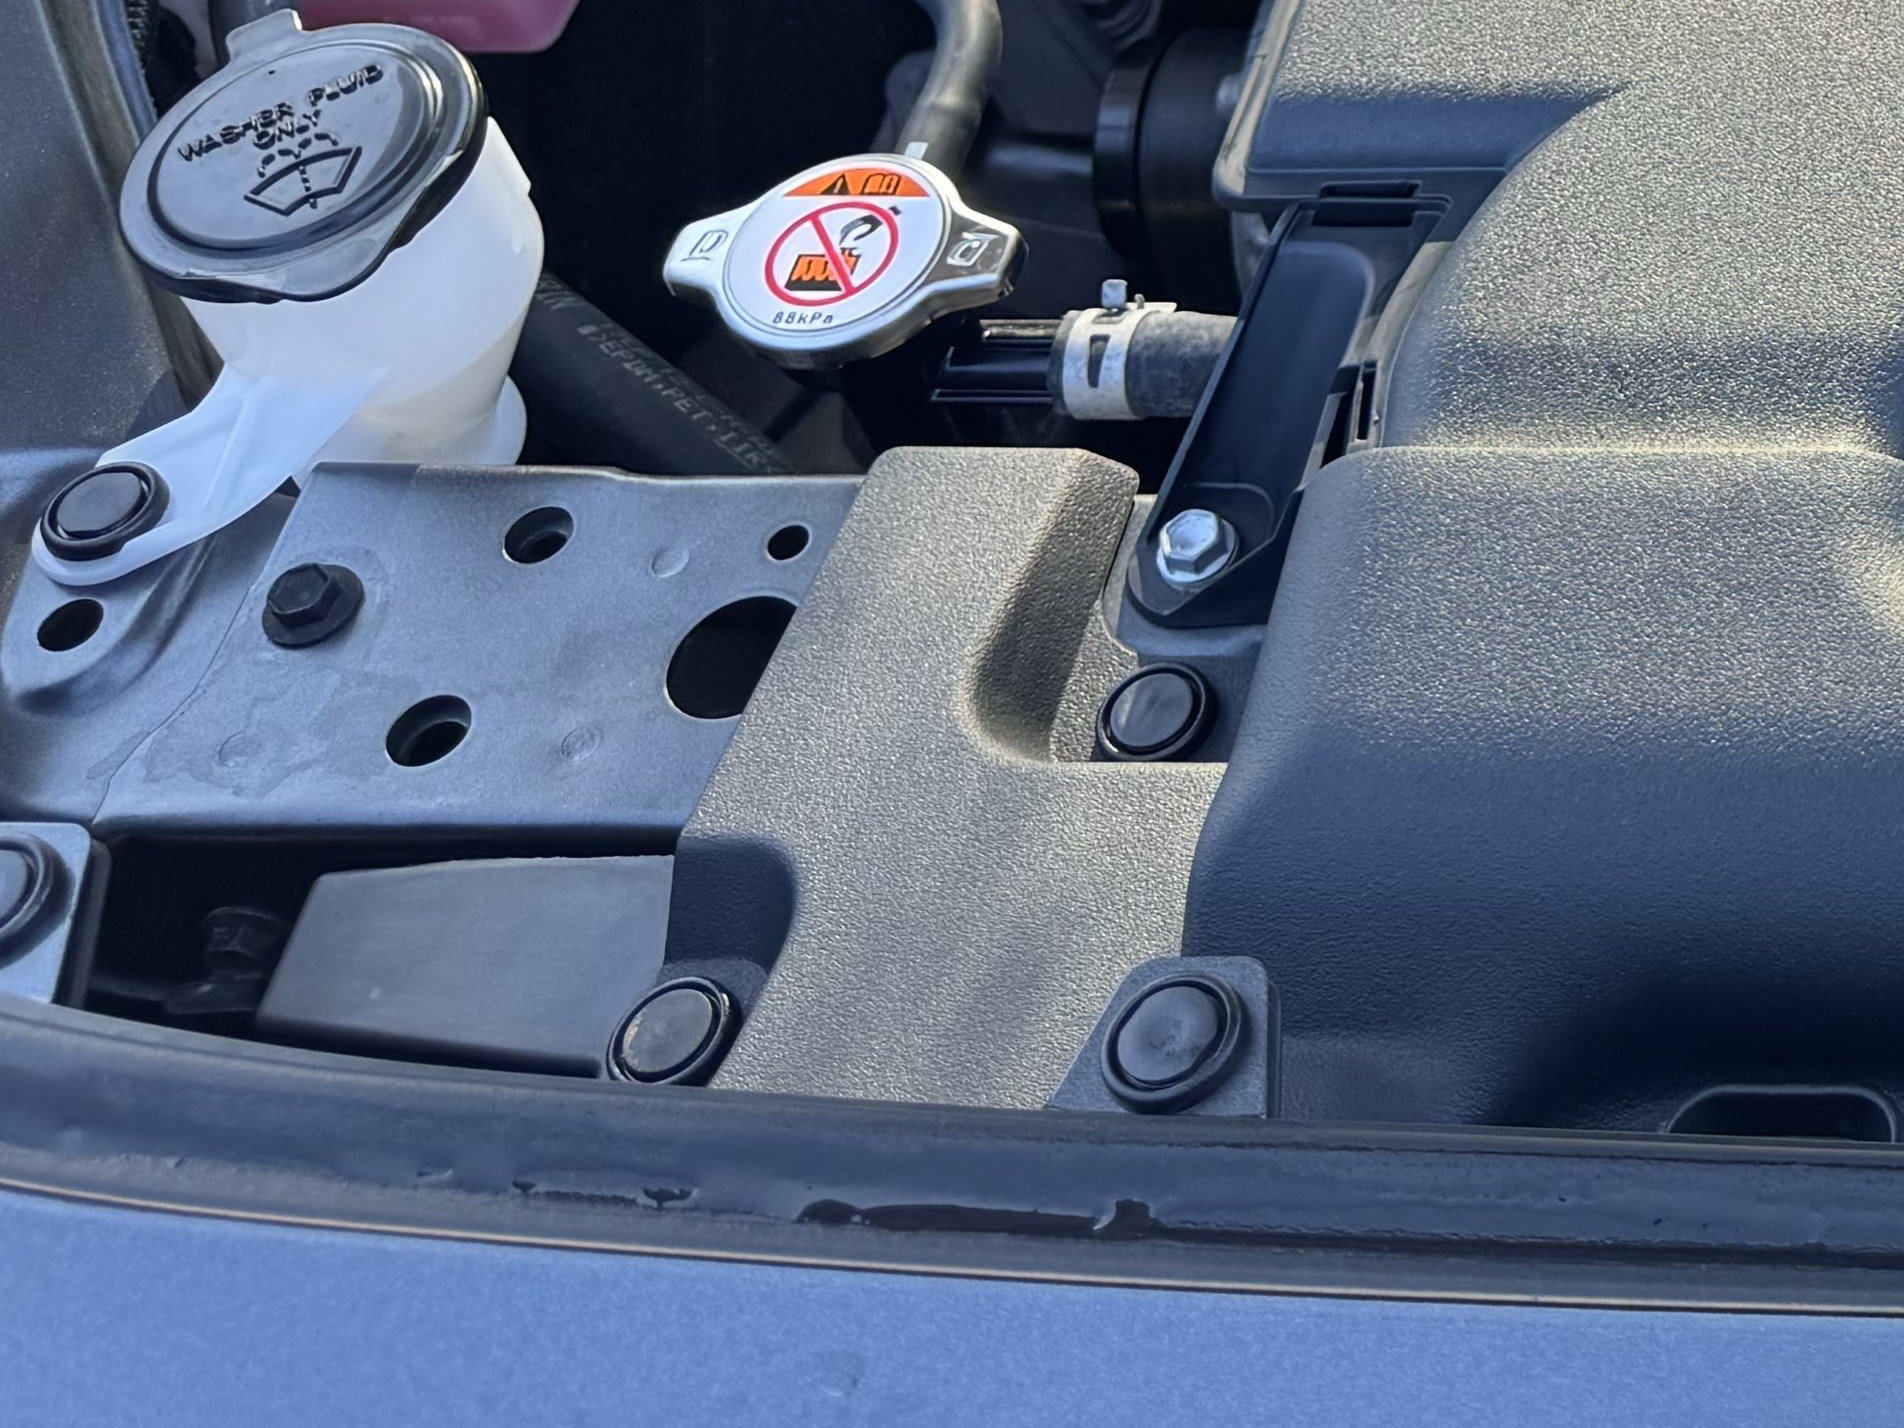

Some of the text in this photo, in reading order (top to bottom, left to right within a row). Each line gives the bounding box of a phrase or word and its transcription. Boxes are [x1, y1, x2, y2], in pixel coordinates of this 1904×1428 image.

[177, 62, 384, 163] WASHER FLUID
[253, 108, 322, 151] ONLY
[772, 310, 835, 325] 88kPa
